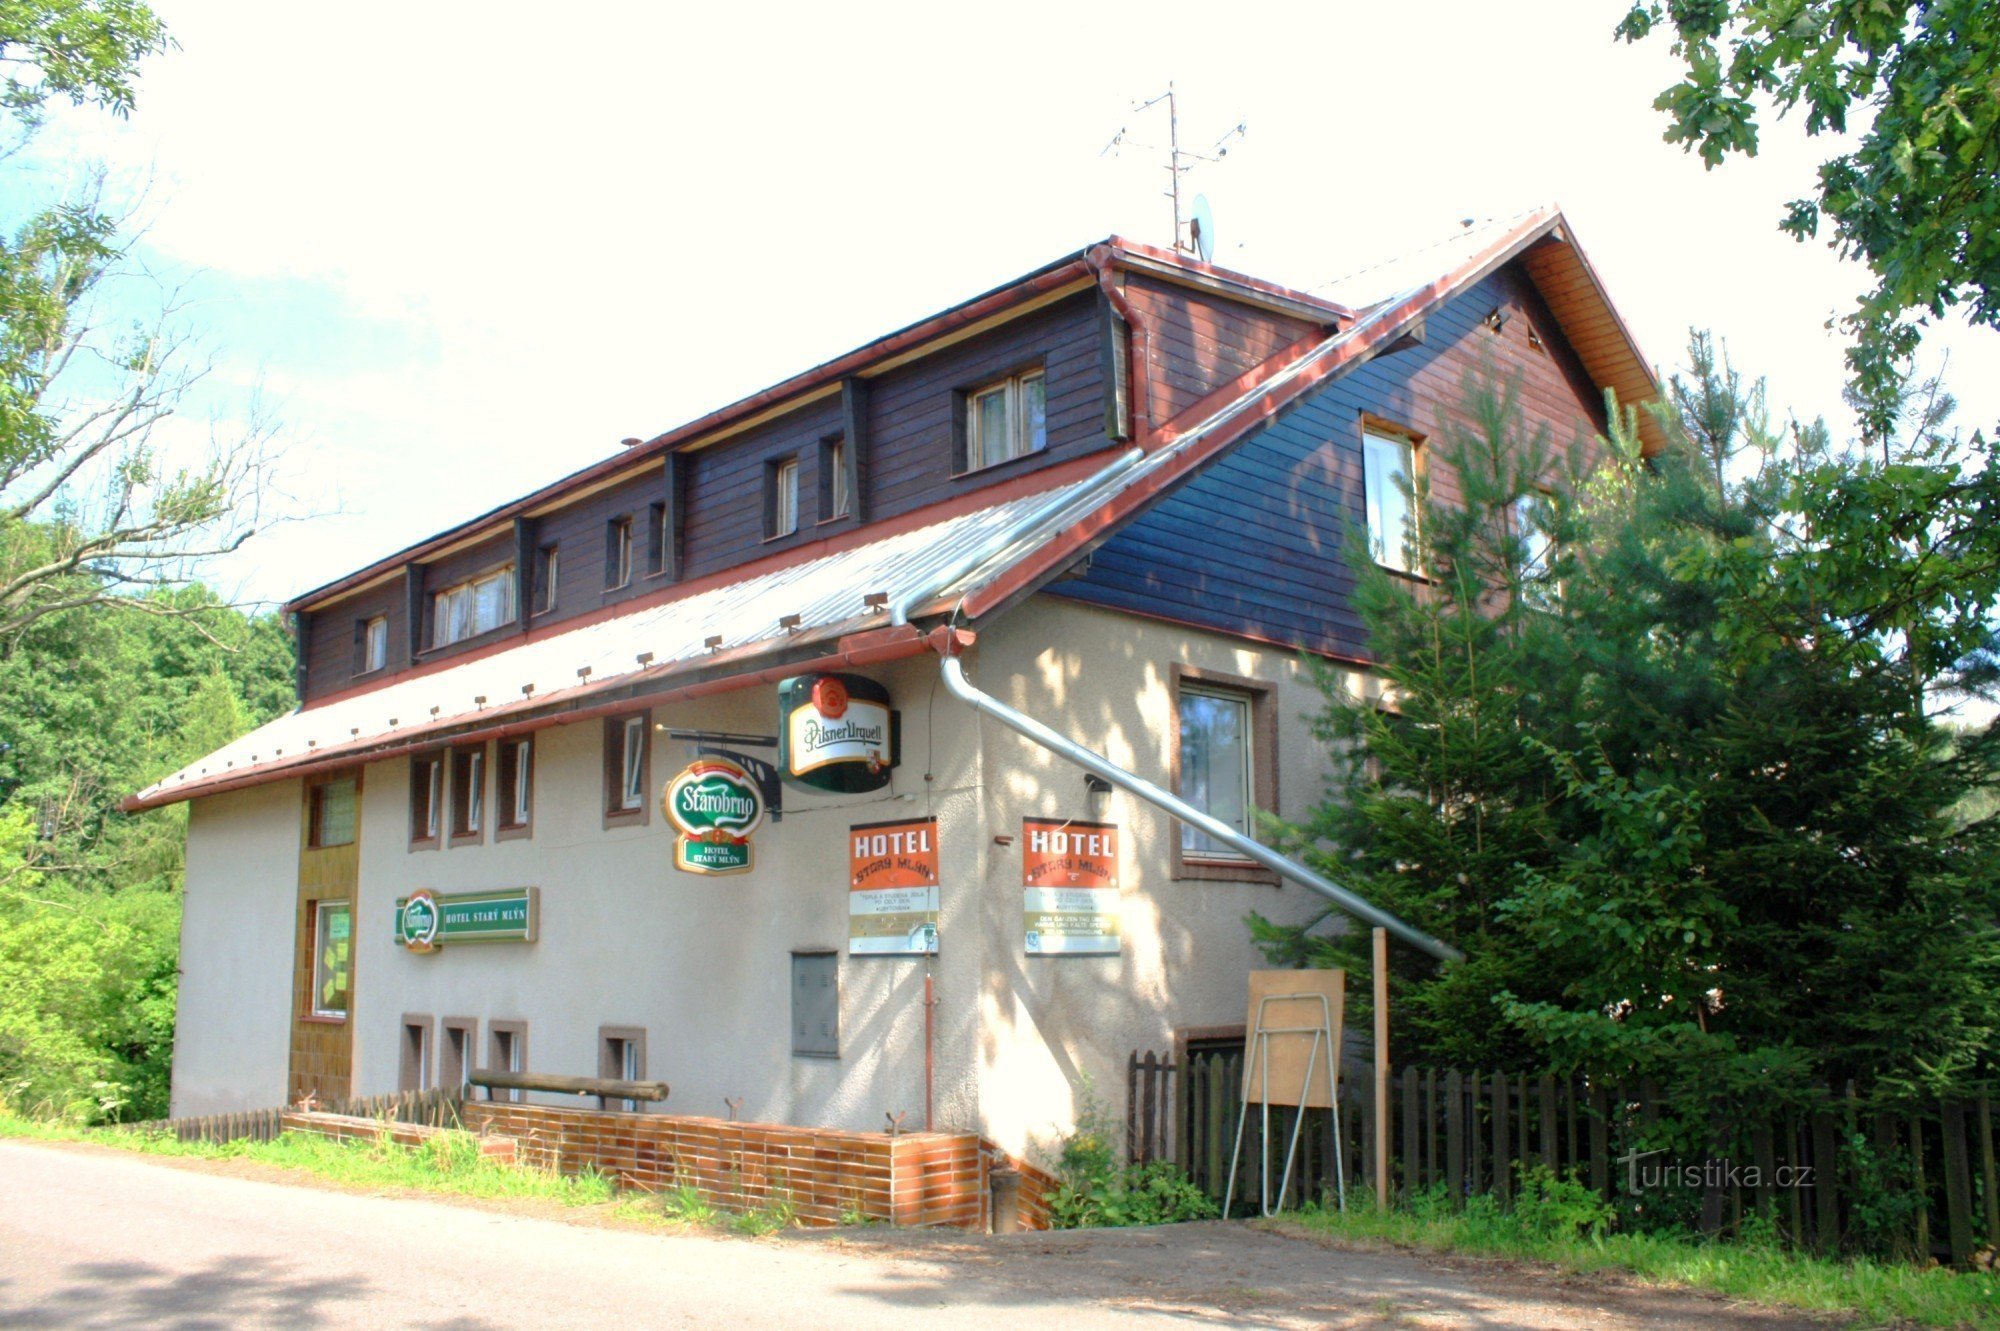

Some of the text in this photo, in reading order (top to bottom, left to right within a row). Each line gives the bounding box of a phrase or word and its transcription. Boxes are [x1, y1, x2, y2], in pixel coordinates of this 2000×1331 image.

[804, 719, 882, 753] Pilsner Urquell
[683, 784, 754, 827] Starobrno
[704, 846, 730, 855] HOTEL
[854, 830, 930, 858] HOTEL
[1031, 830, 1115, 858] HOTEL
[693, 854, 741, 865] STARÝ MLÝN
[446, 907, 525, 924] HOTEL STARÝ MLÝN
